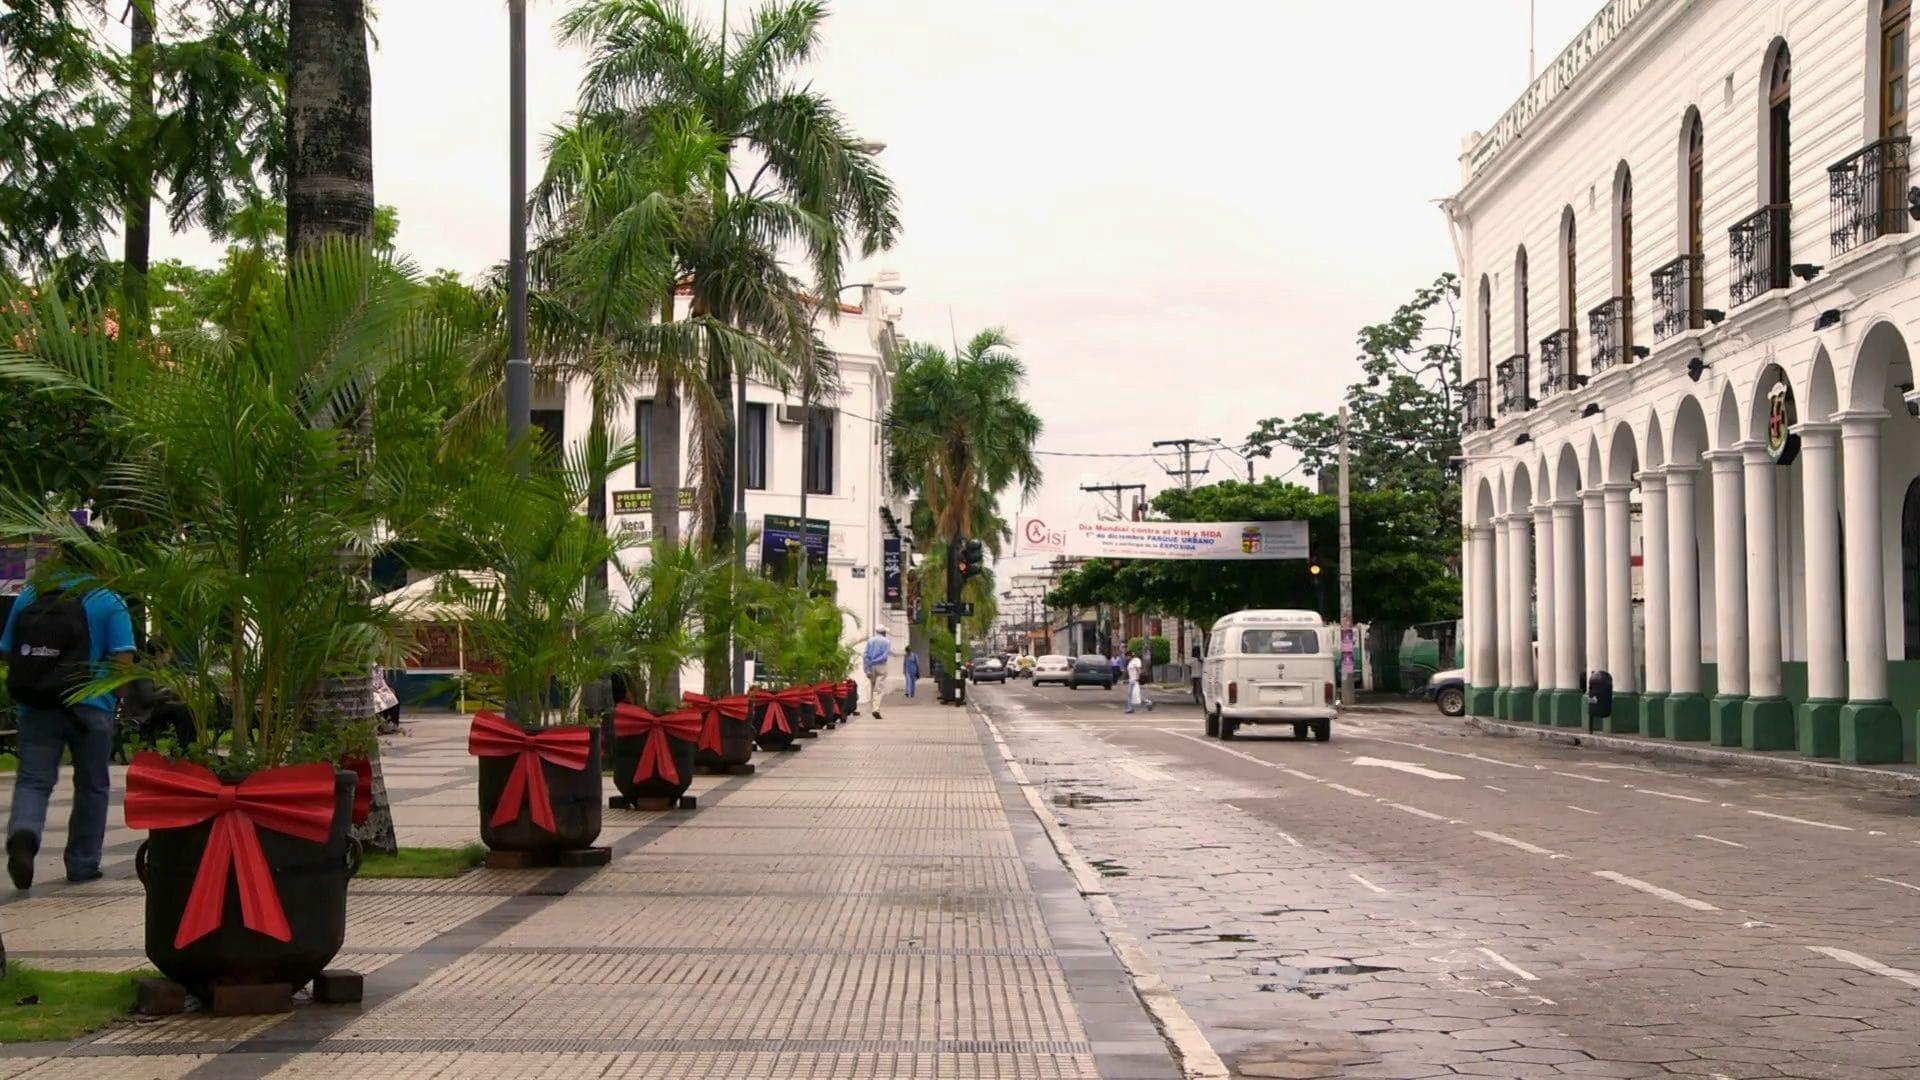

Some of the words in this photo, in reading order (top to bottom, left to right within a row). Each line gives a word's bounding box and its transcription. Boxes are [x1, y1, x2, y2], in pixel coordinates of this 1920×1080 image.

[1096, 524, 1129, 533] Mundial
[1132, 526, 1160, 534] contra
[1201, 530, 1222, 539] SIDA
[1107, 533, 1145, 541] diciembre
[1147, 535, 1178, 543] PARQUE
[1181, 537, 1216, 545] URBANO
